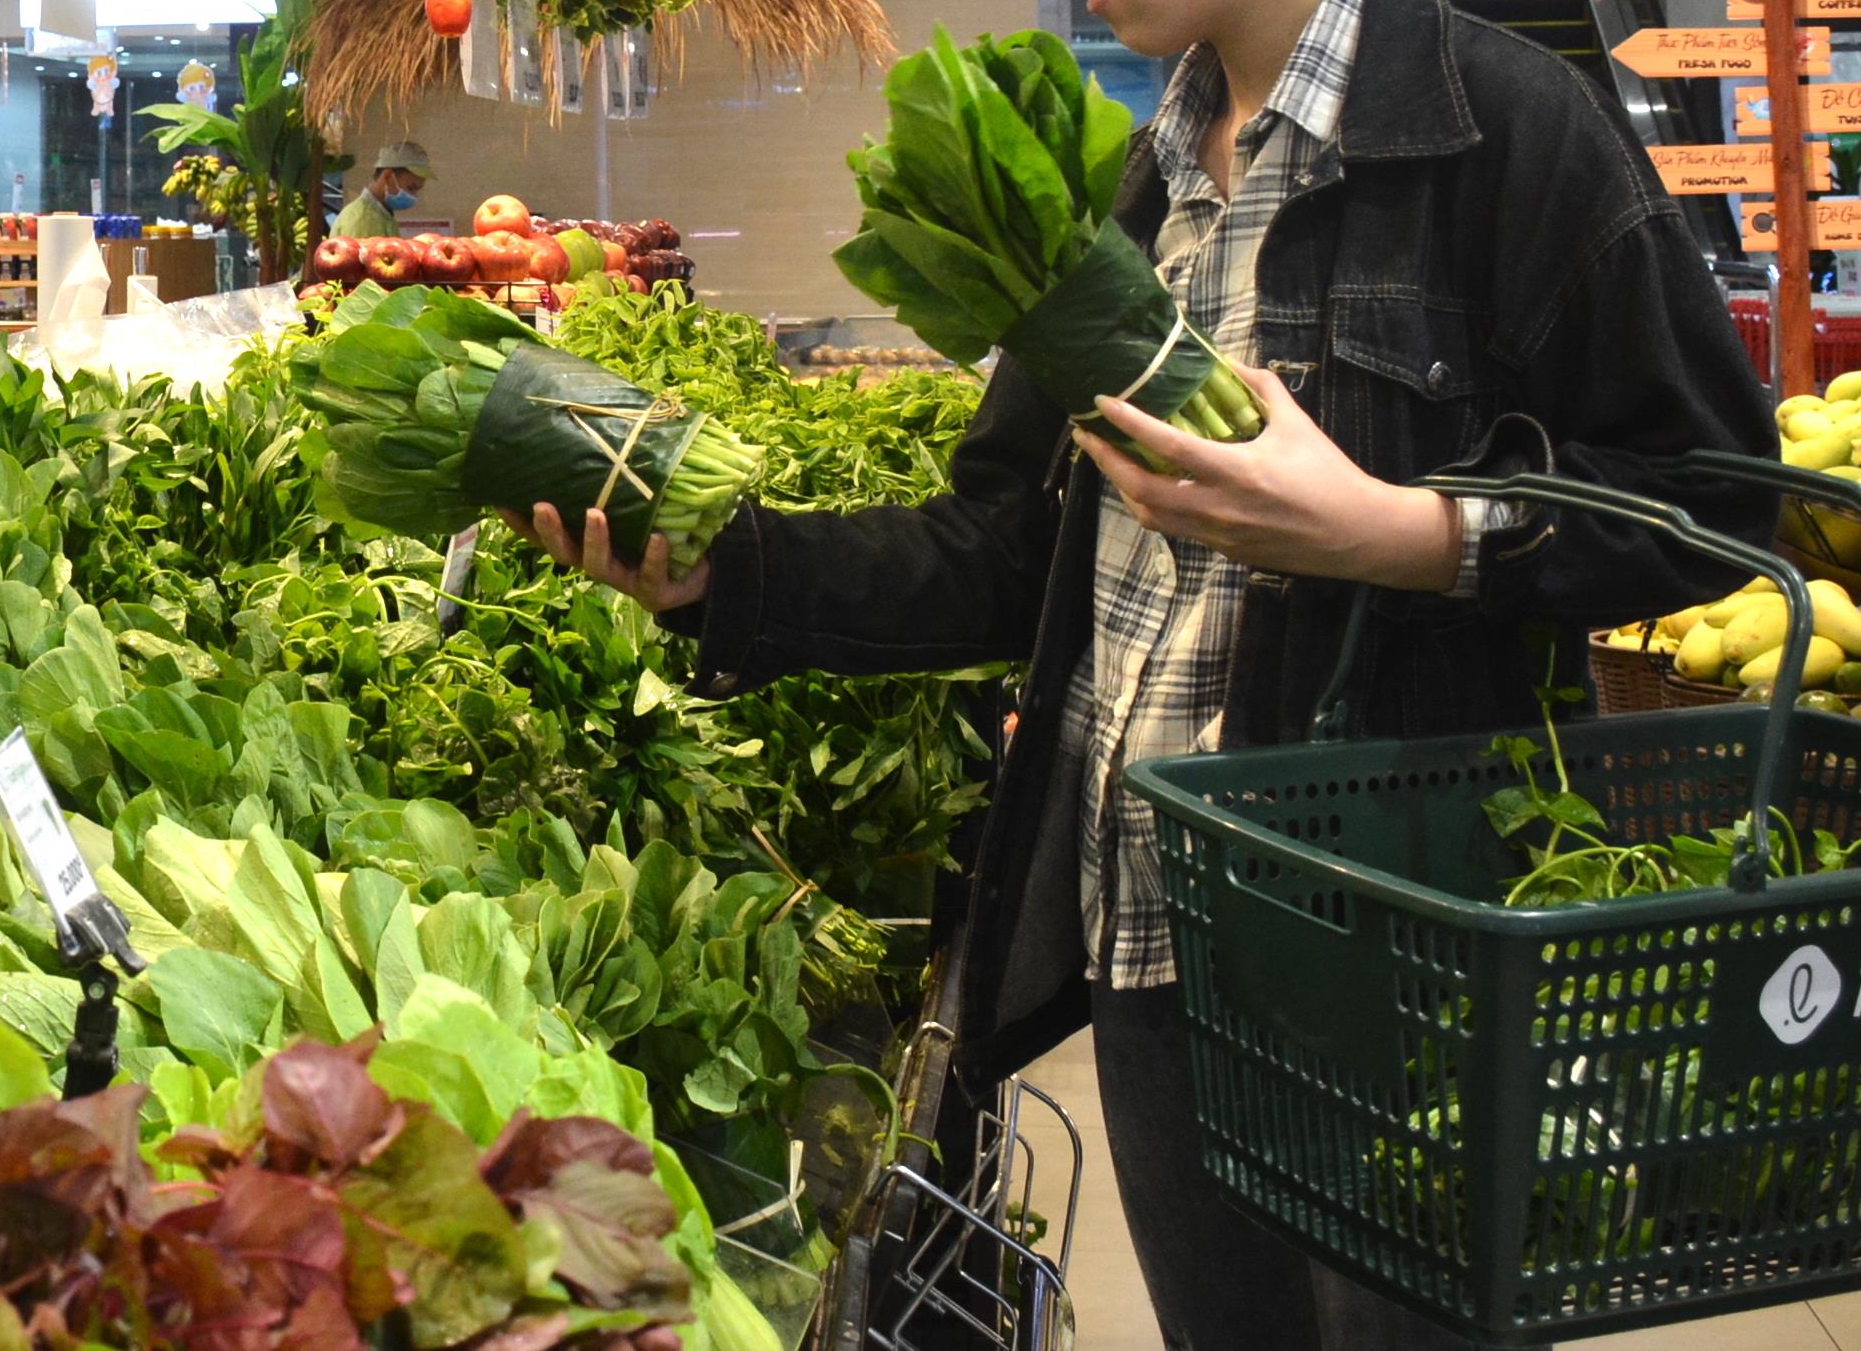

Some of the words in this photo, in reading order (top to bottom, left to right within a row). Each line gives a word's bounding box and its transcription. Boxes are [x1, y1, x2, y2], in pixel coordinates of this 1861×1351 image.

[1678, 58, 1717, 69] FRESH
[1720, 58, 1753, 69] FOOD
[1681, 175, 1749, 187] PROMOTION
